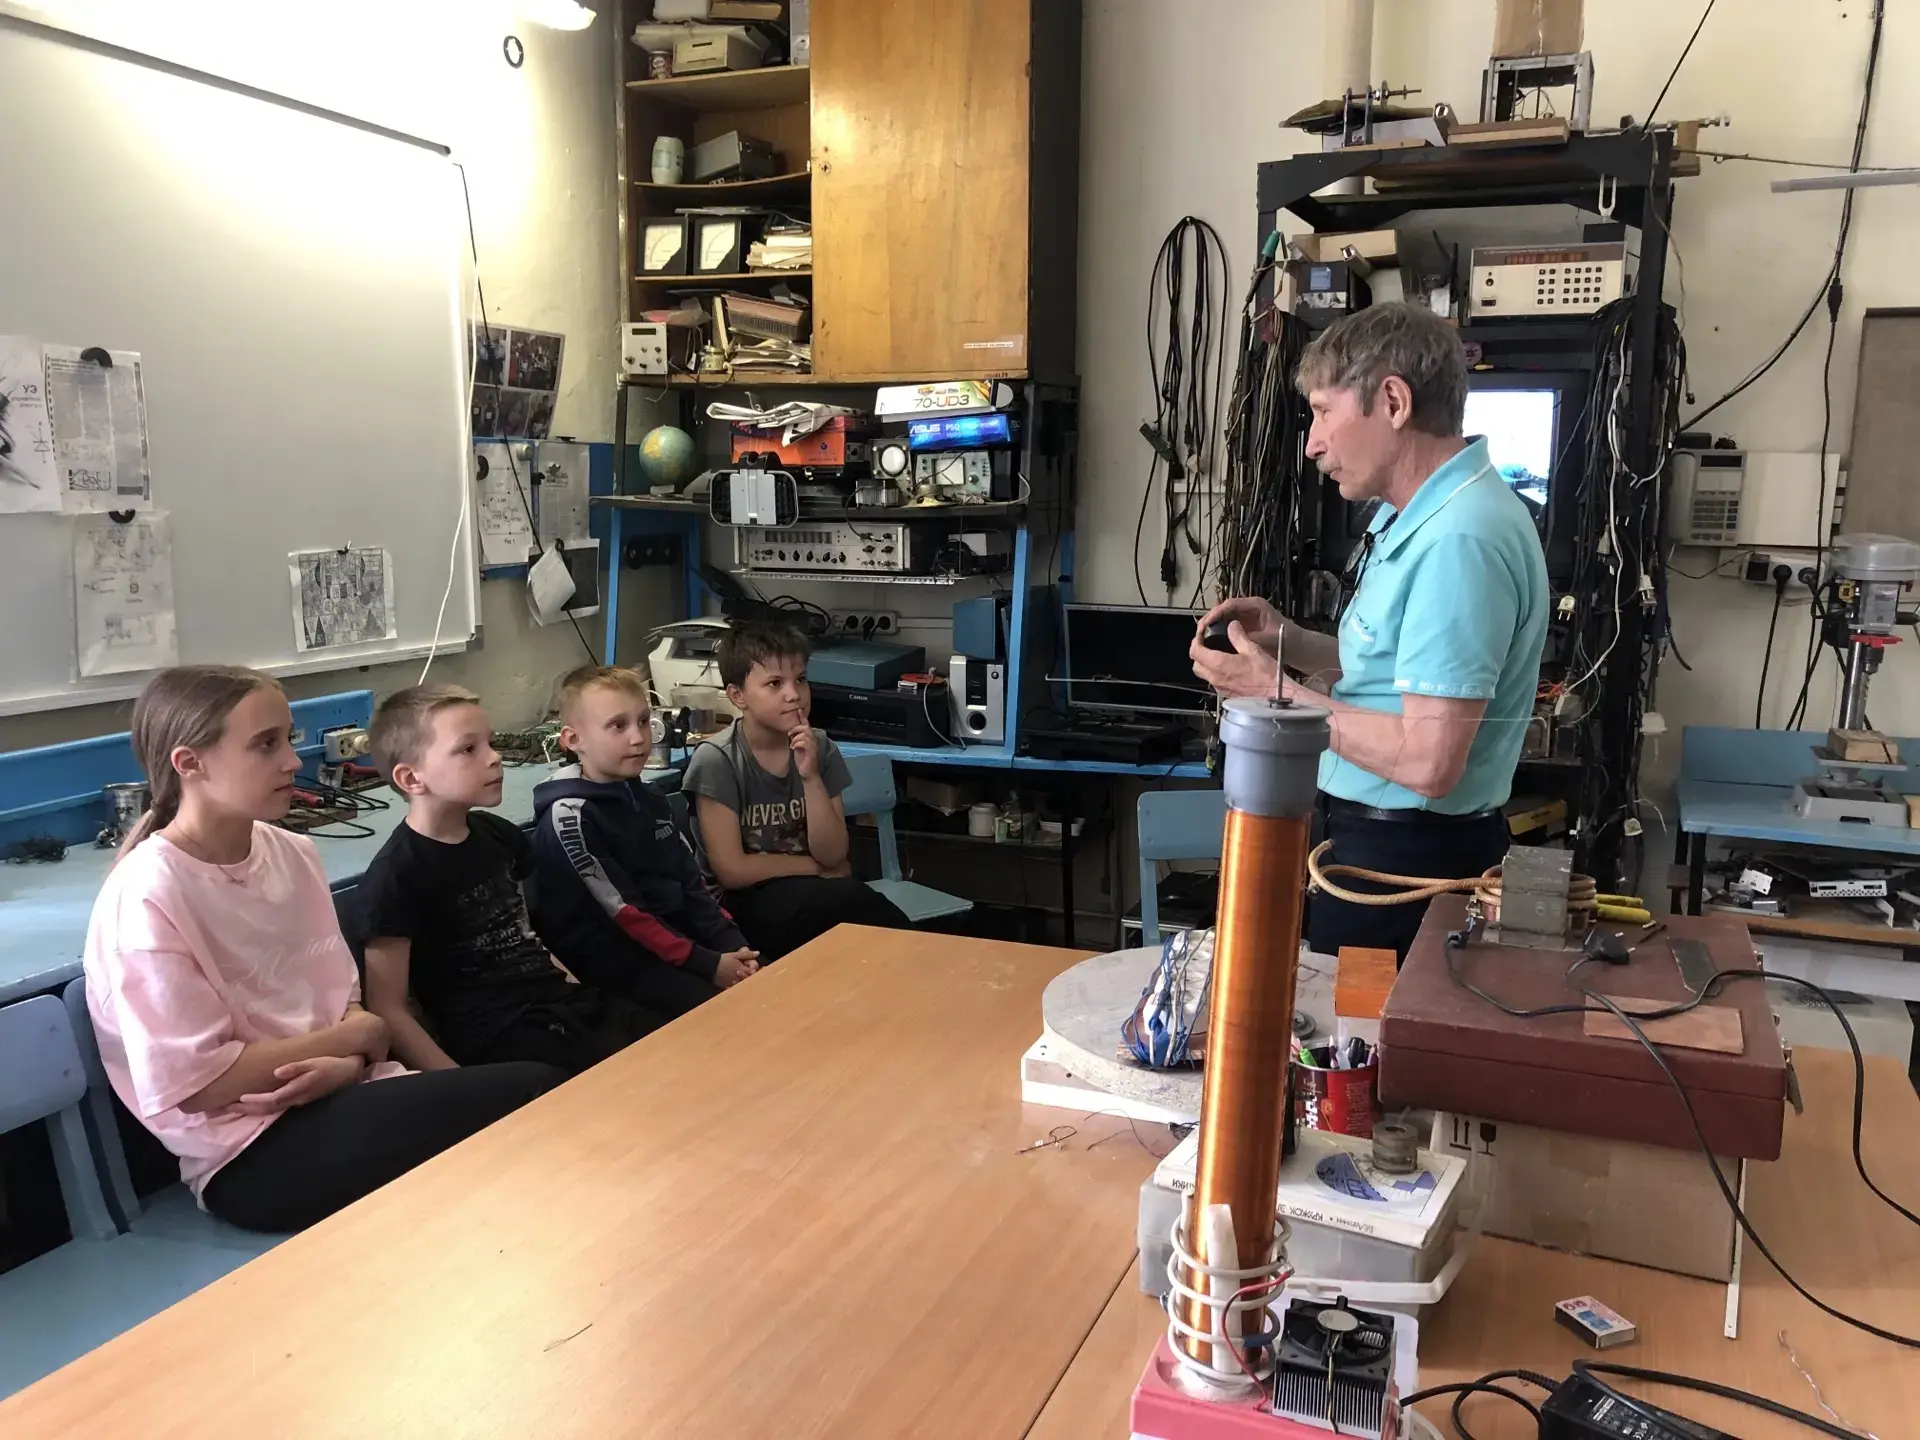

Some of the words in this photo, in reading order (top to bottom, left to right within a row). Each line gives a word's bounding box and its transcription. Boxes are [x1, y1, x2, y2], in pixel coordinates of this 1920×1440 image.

[910, 423, 941, 434] ASUS
[848, 693, 868, 701] Canon
[741, 803, 788, 827] NEVER
[789, 797, 805, 820] GI
[558, 815, 596, 872] PUMA
[1288, 1204, 1324, 1222] КРУЖОК
